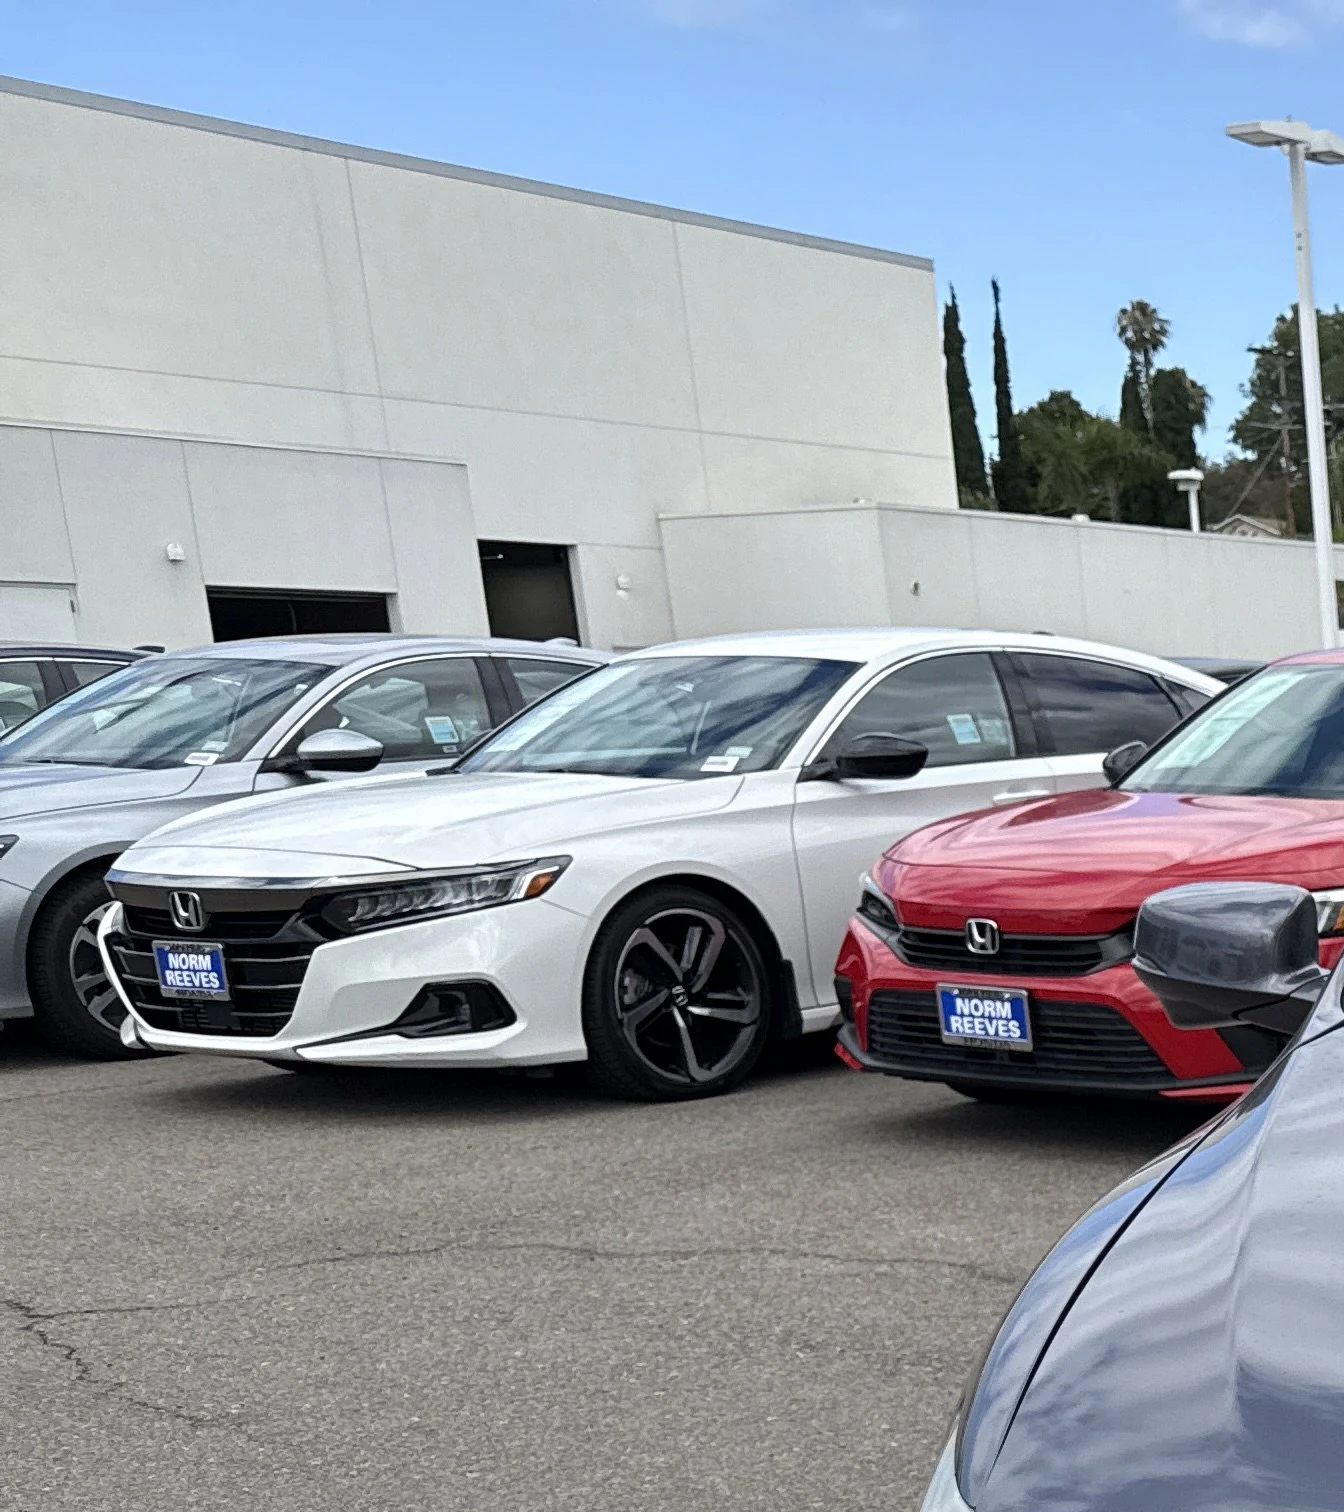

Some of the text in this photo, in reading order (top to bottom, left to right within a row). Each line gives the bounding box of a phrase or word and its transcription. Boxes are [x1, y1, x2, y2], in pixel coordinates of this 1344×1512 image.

[167, 952, 212, 971] NORM
[165, 970, 220, 988] REEVES
[955, 997, 1012, 1019] NORM
[950, 1015, 1021, 1038] REEVES
